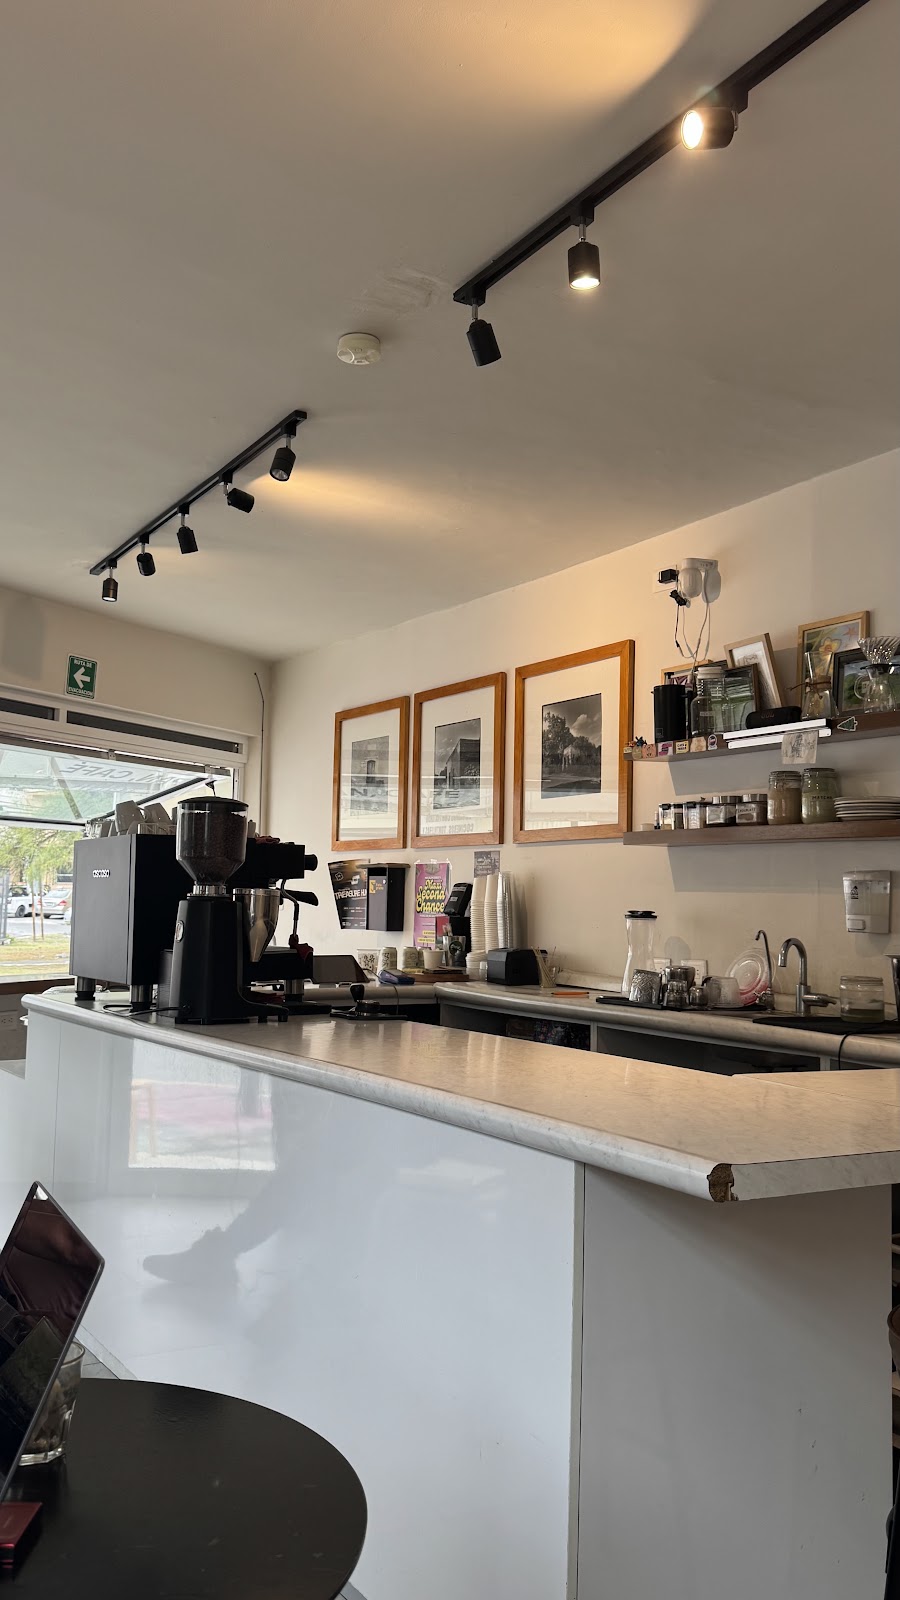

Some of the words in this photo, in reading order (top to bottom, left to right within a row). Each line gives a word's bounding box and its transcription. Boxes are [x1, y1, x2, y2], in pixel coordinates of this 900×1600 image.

[335, 889, 361, 900] TREASURE
[416, 885, 446, 901] Second
[416, 898, 445, 913] Chance
